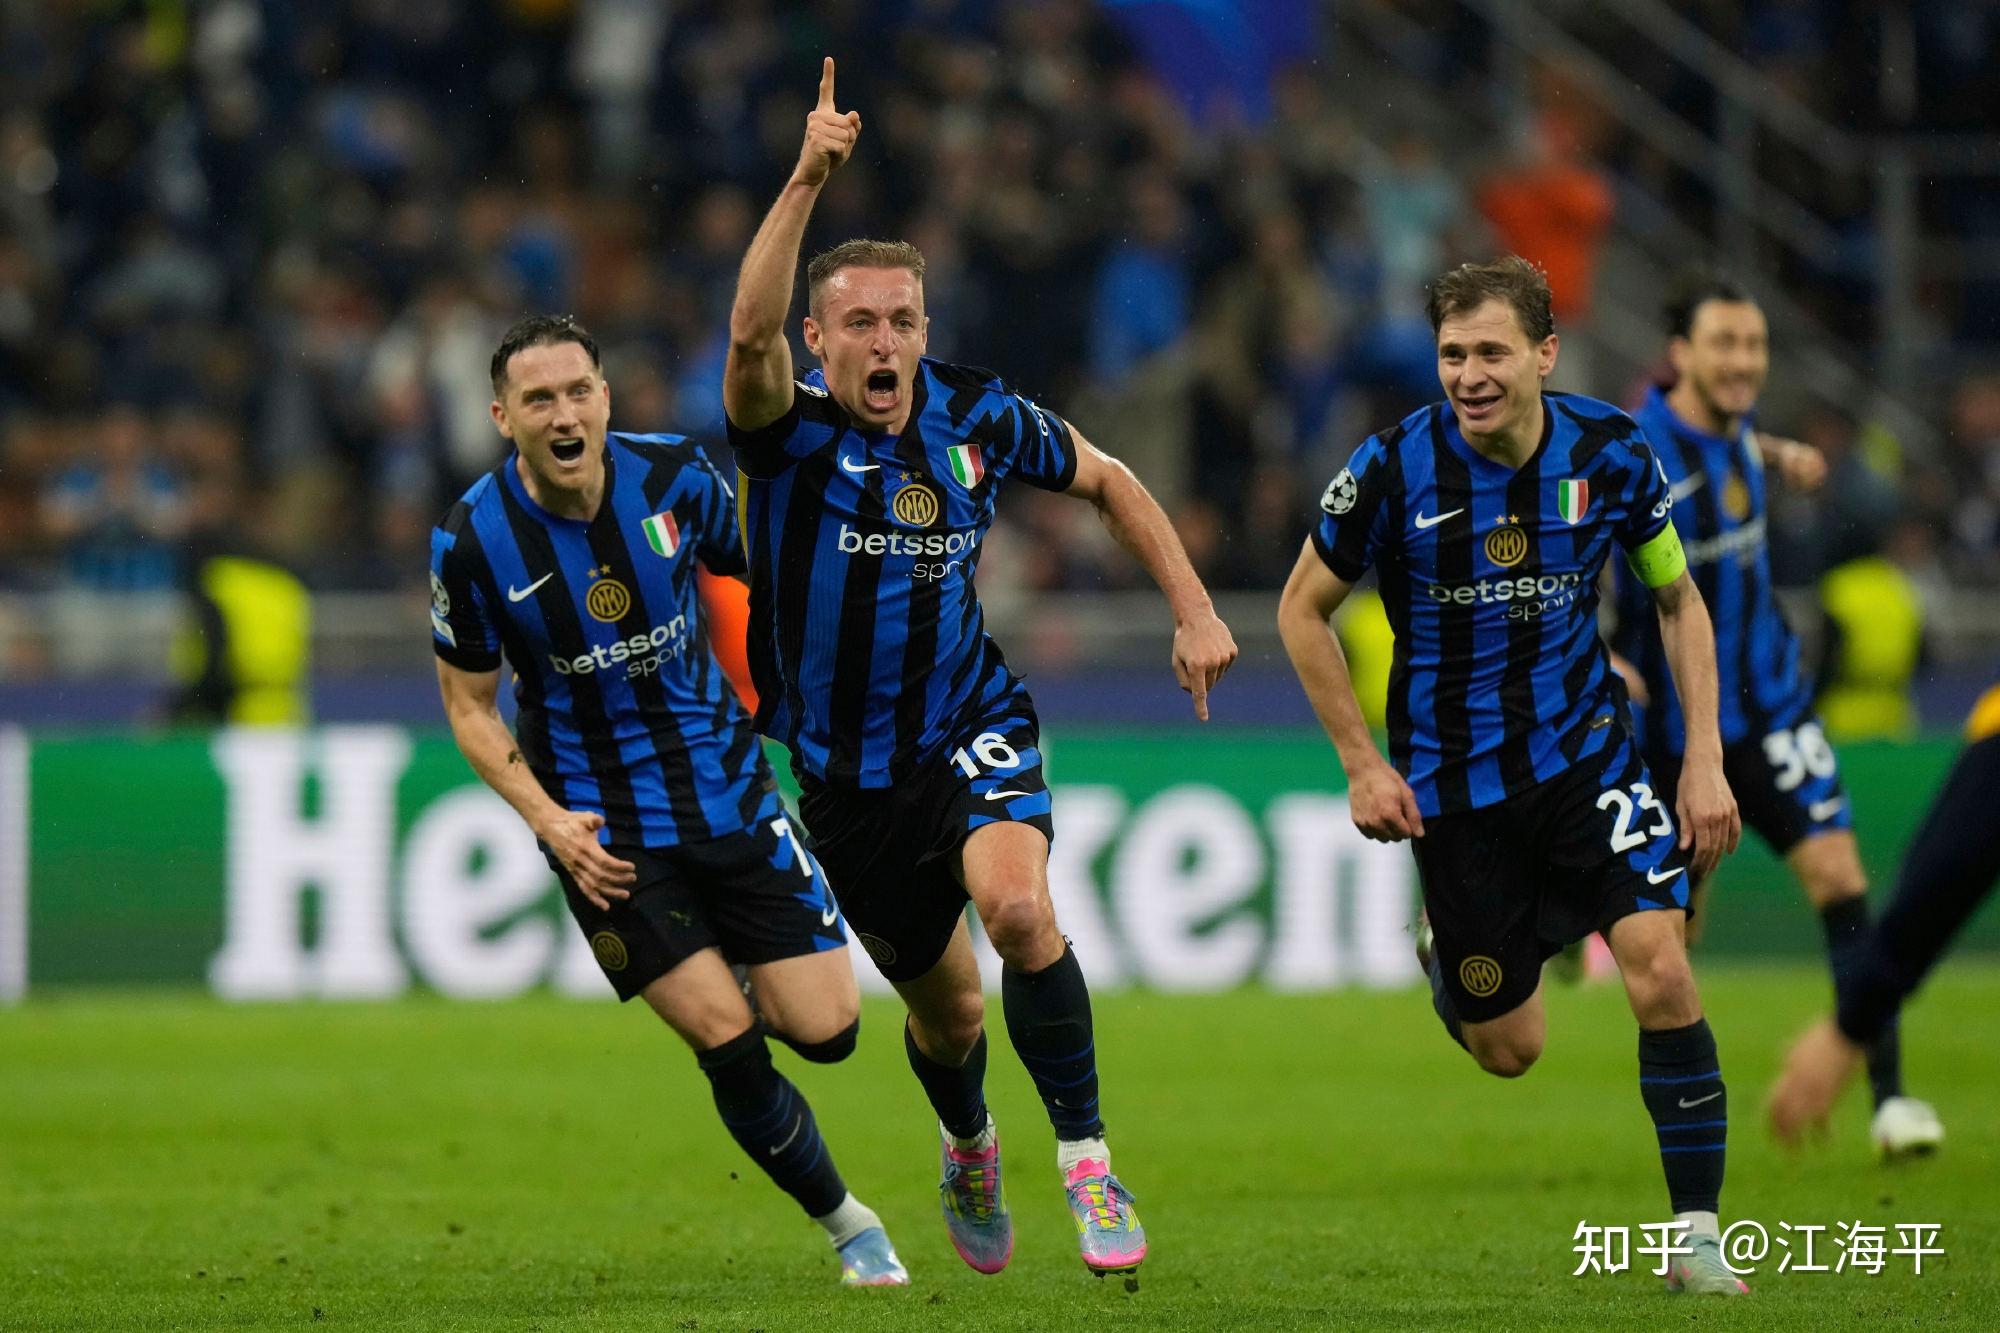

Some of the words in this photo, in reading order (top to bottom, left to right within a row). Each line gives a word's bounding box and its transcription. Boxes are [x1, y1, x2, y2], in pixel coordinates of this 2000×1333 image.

[837, 524, 976, 556] betsson
[1428, 572, 1580, 605] betsson
[548, 614, 686, 675] betsson
[949, 732, 1020, 780] 16
[1595, 782, 1672, 855] 23
[769, 816, 814, 878] 7
